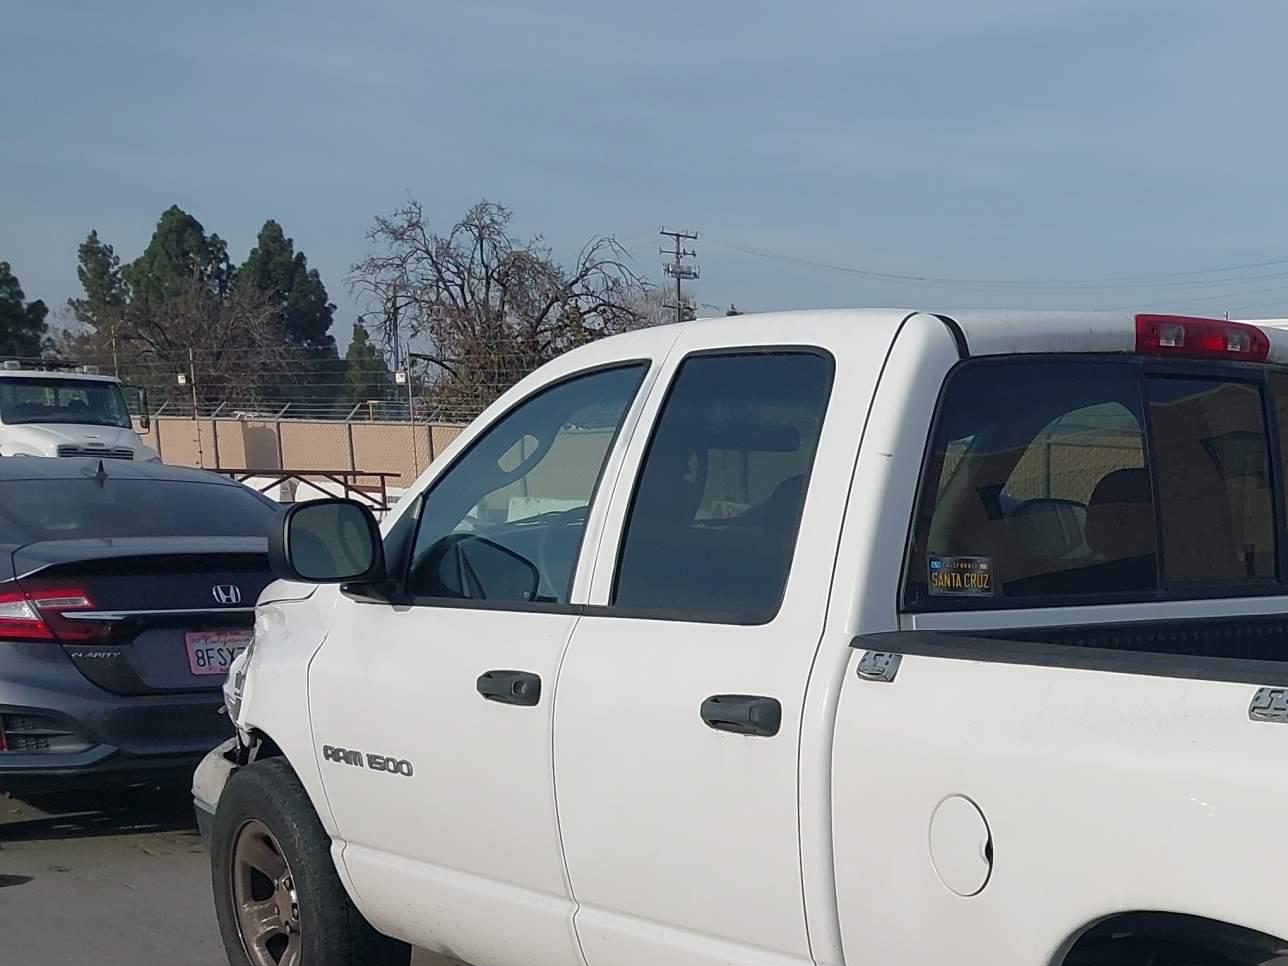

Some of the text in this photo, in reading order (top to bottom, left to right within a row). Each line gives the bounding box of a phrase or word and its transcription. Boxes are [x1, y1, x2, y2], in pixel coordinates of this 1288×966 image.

[931, 572, 990, 588] SANTA CRUZ
[322, 744, 413, 777] RAM 1500
